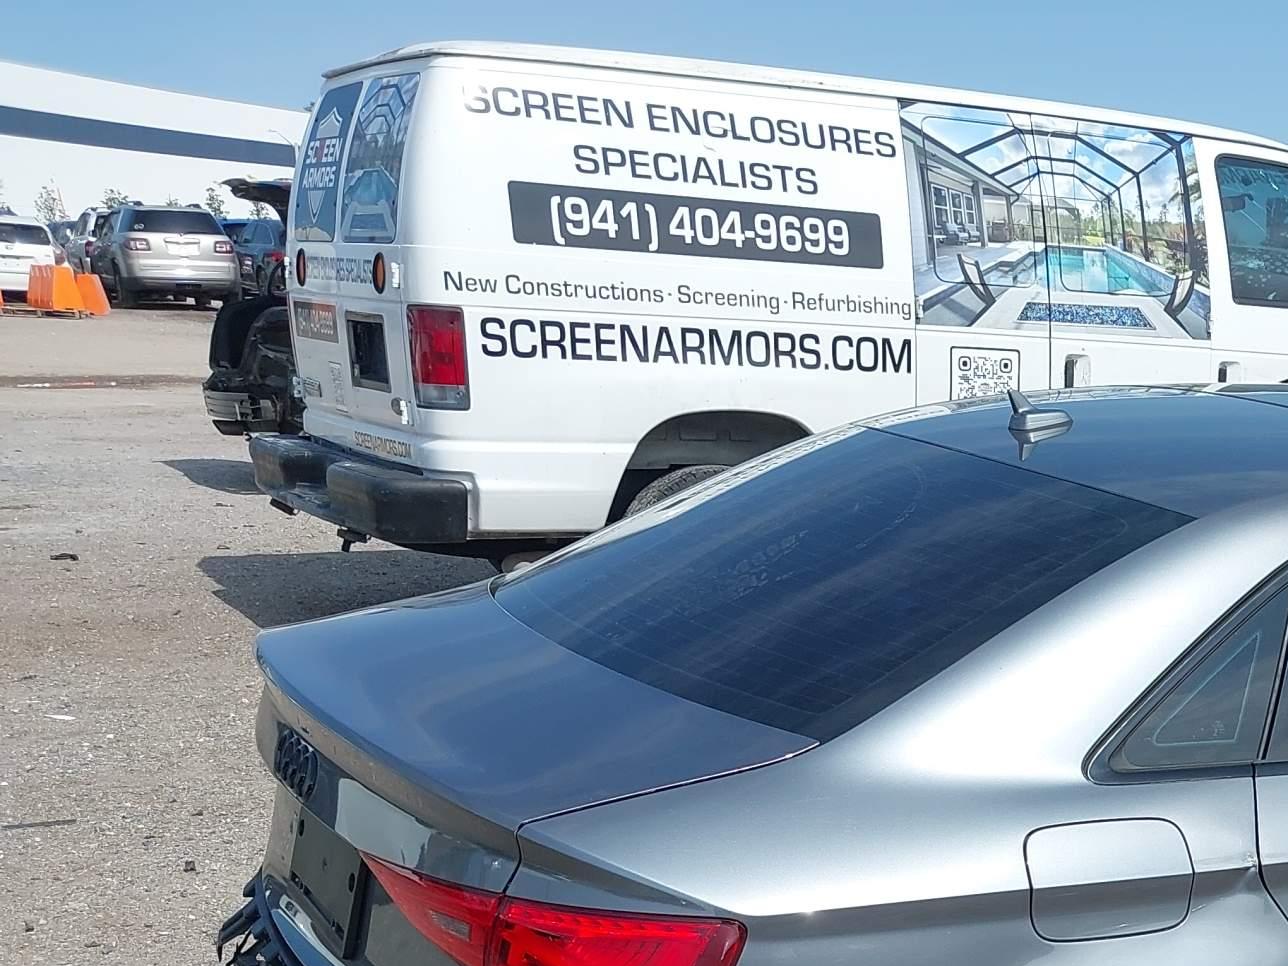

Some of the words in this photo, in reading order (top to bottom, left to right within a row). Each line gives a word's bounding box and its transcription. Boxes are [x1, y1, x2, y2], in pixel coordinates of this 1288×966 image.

[462, 85, 634, 129] SCREEN
[646, 103, 897, 158] ENCLOSURES
[303, 166, 337, 188] ARMORS
[573, 144, 818, 195] SPECIALISTS
[549, 194, 658, 251] (941)
[668, 206, 850, 256] 404-9699
[443, 271, 498, 293] New
[505, 274, 664, 303] Constructions
[677, 284, 780, 314] Screening
[792, 292, 912, 321] Refurbishing
[481, 316, 912, 374] SCREENARMORS.COM
